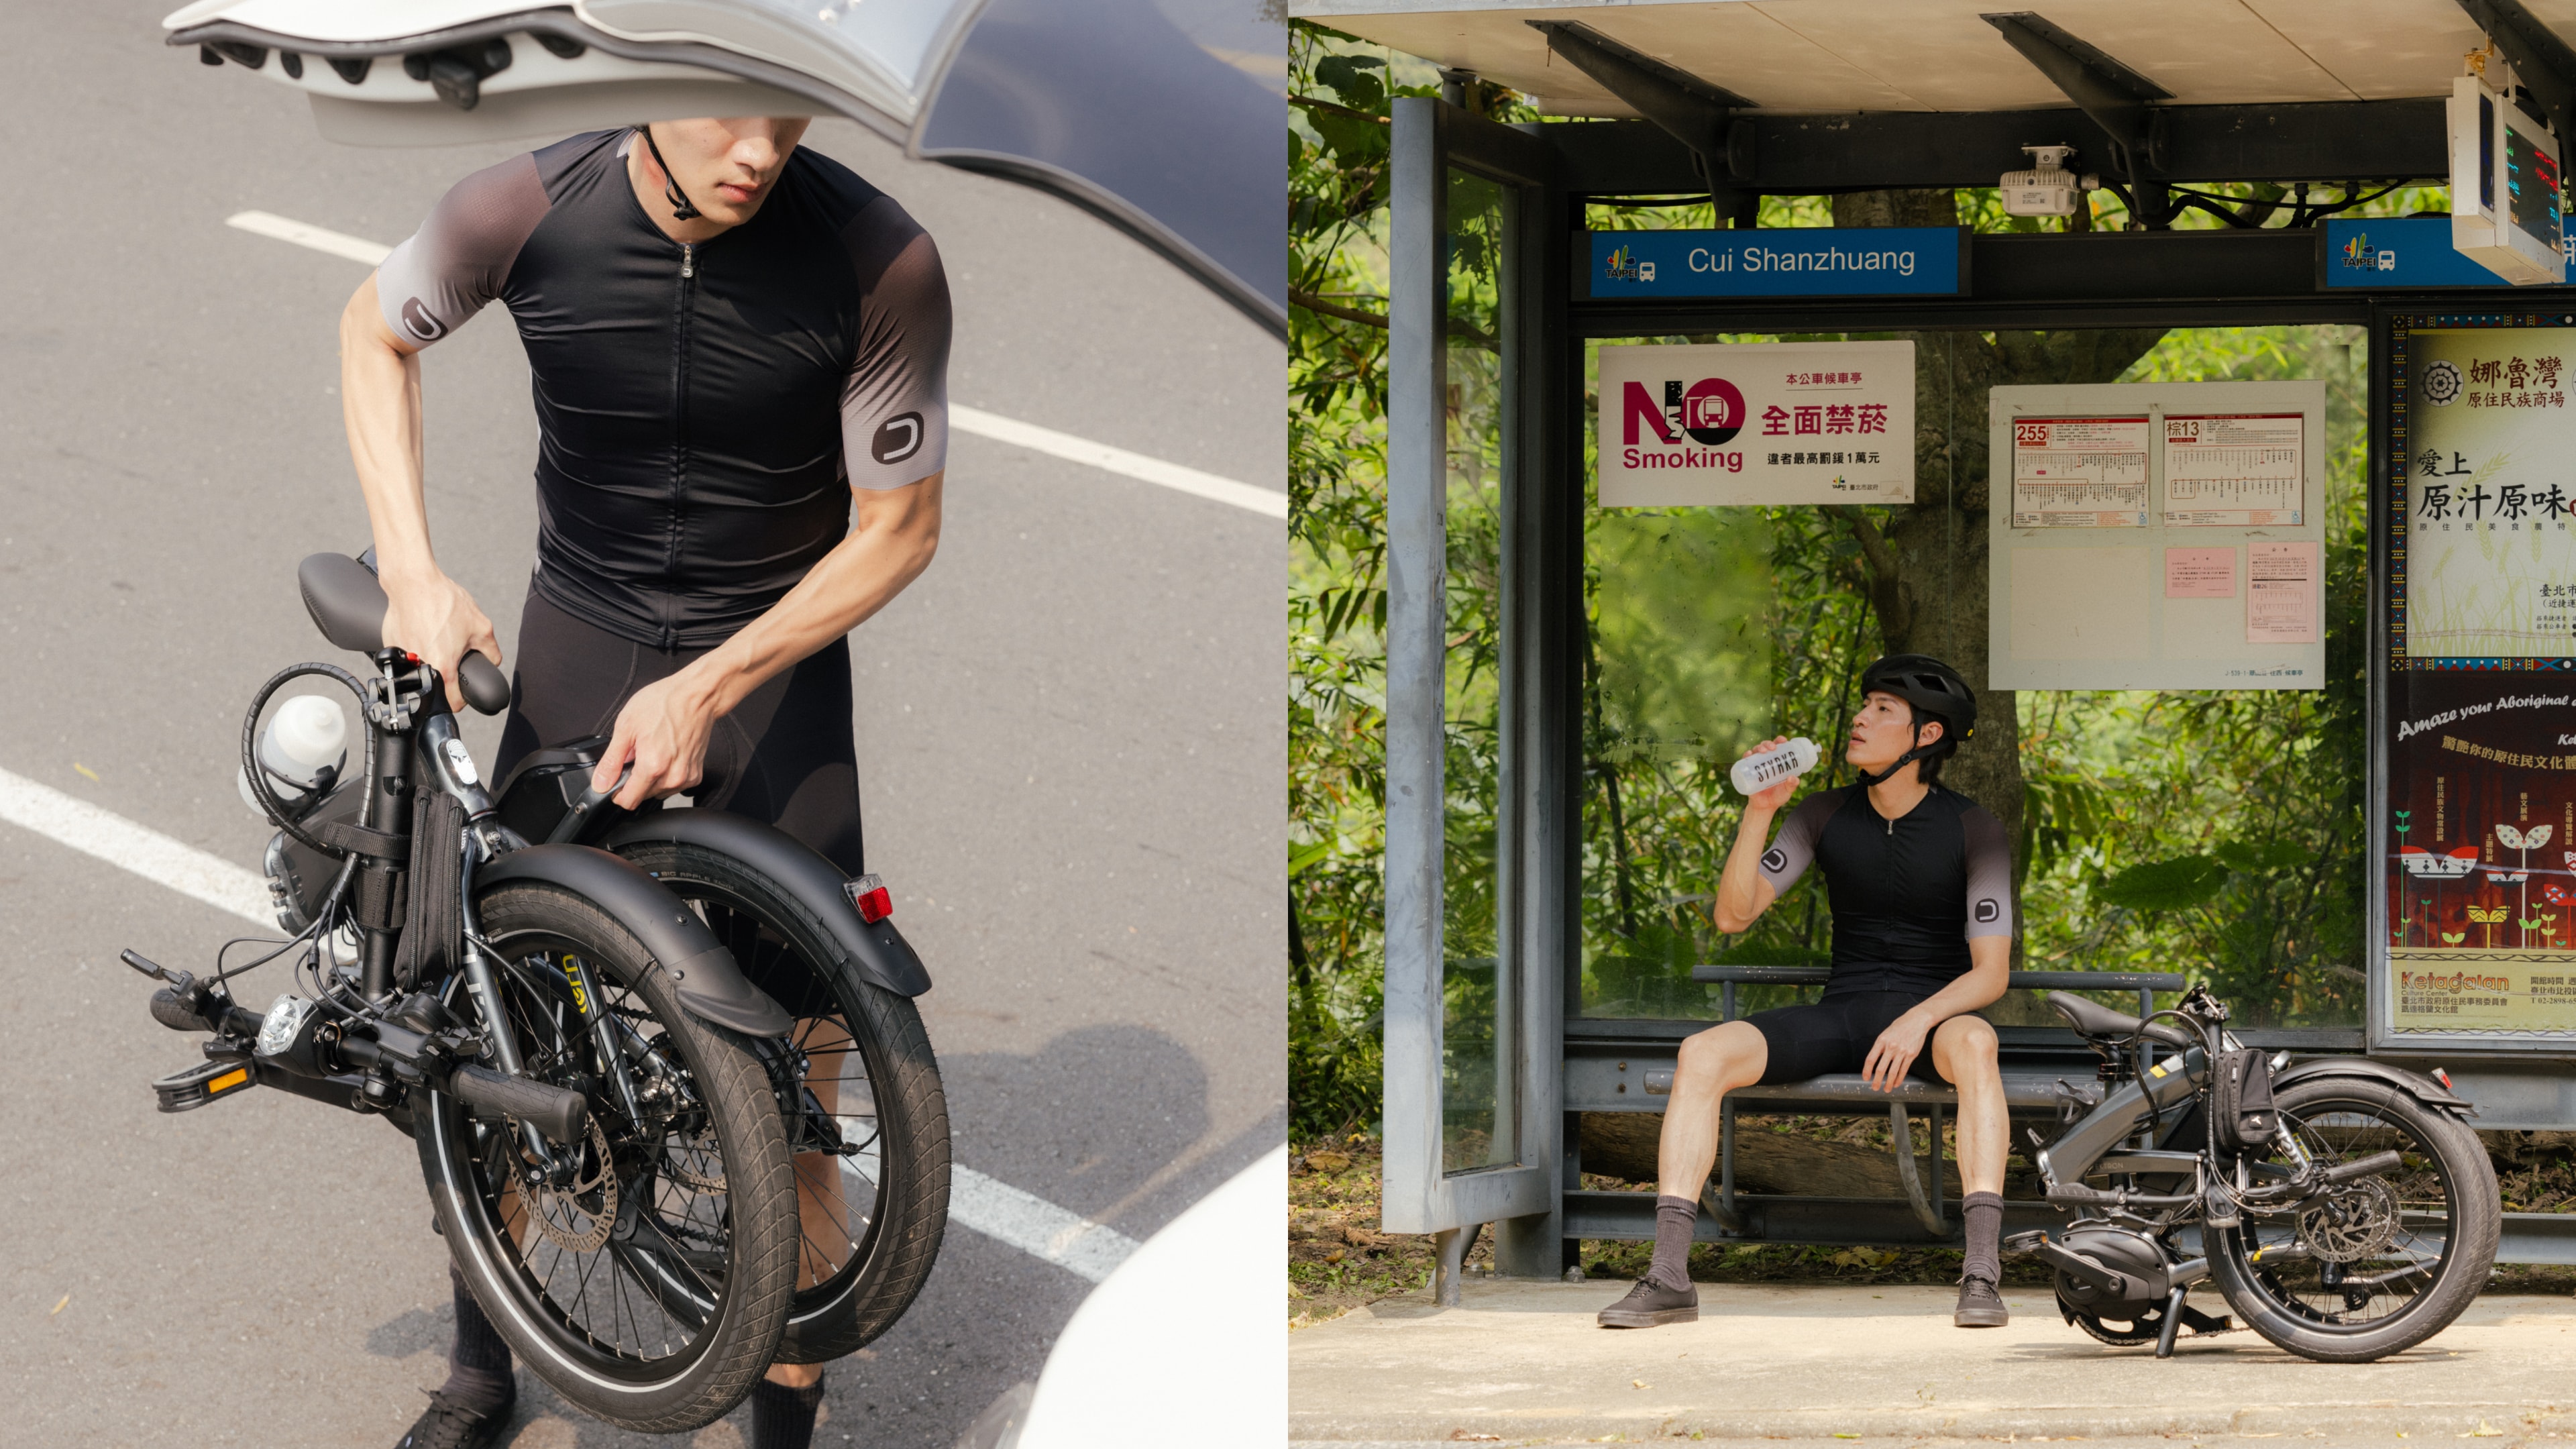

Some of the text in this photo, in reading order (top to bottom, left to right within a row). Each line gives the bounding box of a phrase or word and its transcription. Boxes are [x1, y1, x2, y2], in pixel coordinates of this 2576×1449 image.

[1605, 268, 1638, 278] TAIPEI
[1688, 246, 1915, 276] Cui Shanzhuang
[2342, 257, 2376, 268] TAIPEI
[1786, 372, 1862, 385] 本公車候車亭
[2469, 356, 2563, 389] 娜魯灣
[1623, 377, 1746, 446] NO
[2466, 390, 2565, 408] 原住民族商場
[1761, 403, 1888, 436] 全面禁菸
[2017, 425, 2046, 441] 255
[2167, 421, 2199, 436] 棕13
[1623, 447, 1743, 473] Smoking
[2416, 449, 2472, 477] 愛上
[2416, 484, 2571, 521] 原汁原味
[2398, 710, 2457, 741] Amaze
[2460, 703, 2492, 720] your
[2496, 694, 2569, 710] Aboriginal
[2485, 833, 2493, 862] 主題特展
[2402, 971, 2509, 994] Ketagalan
